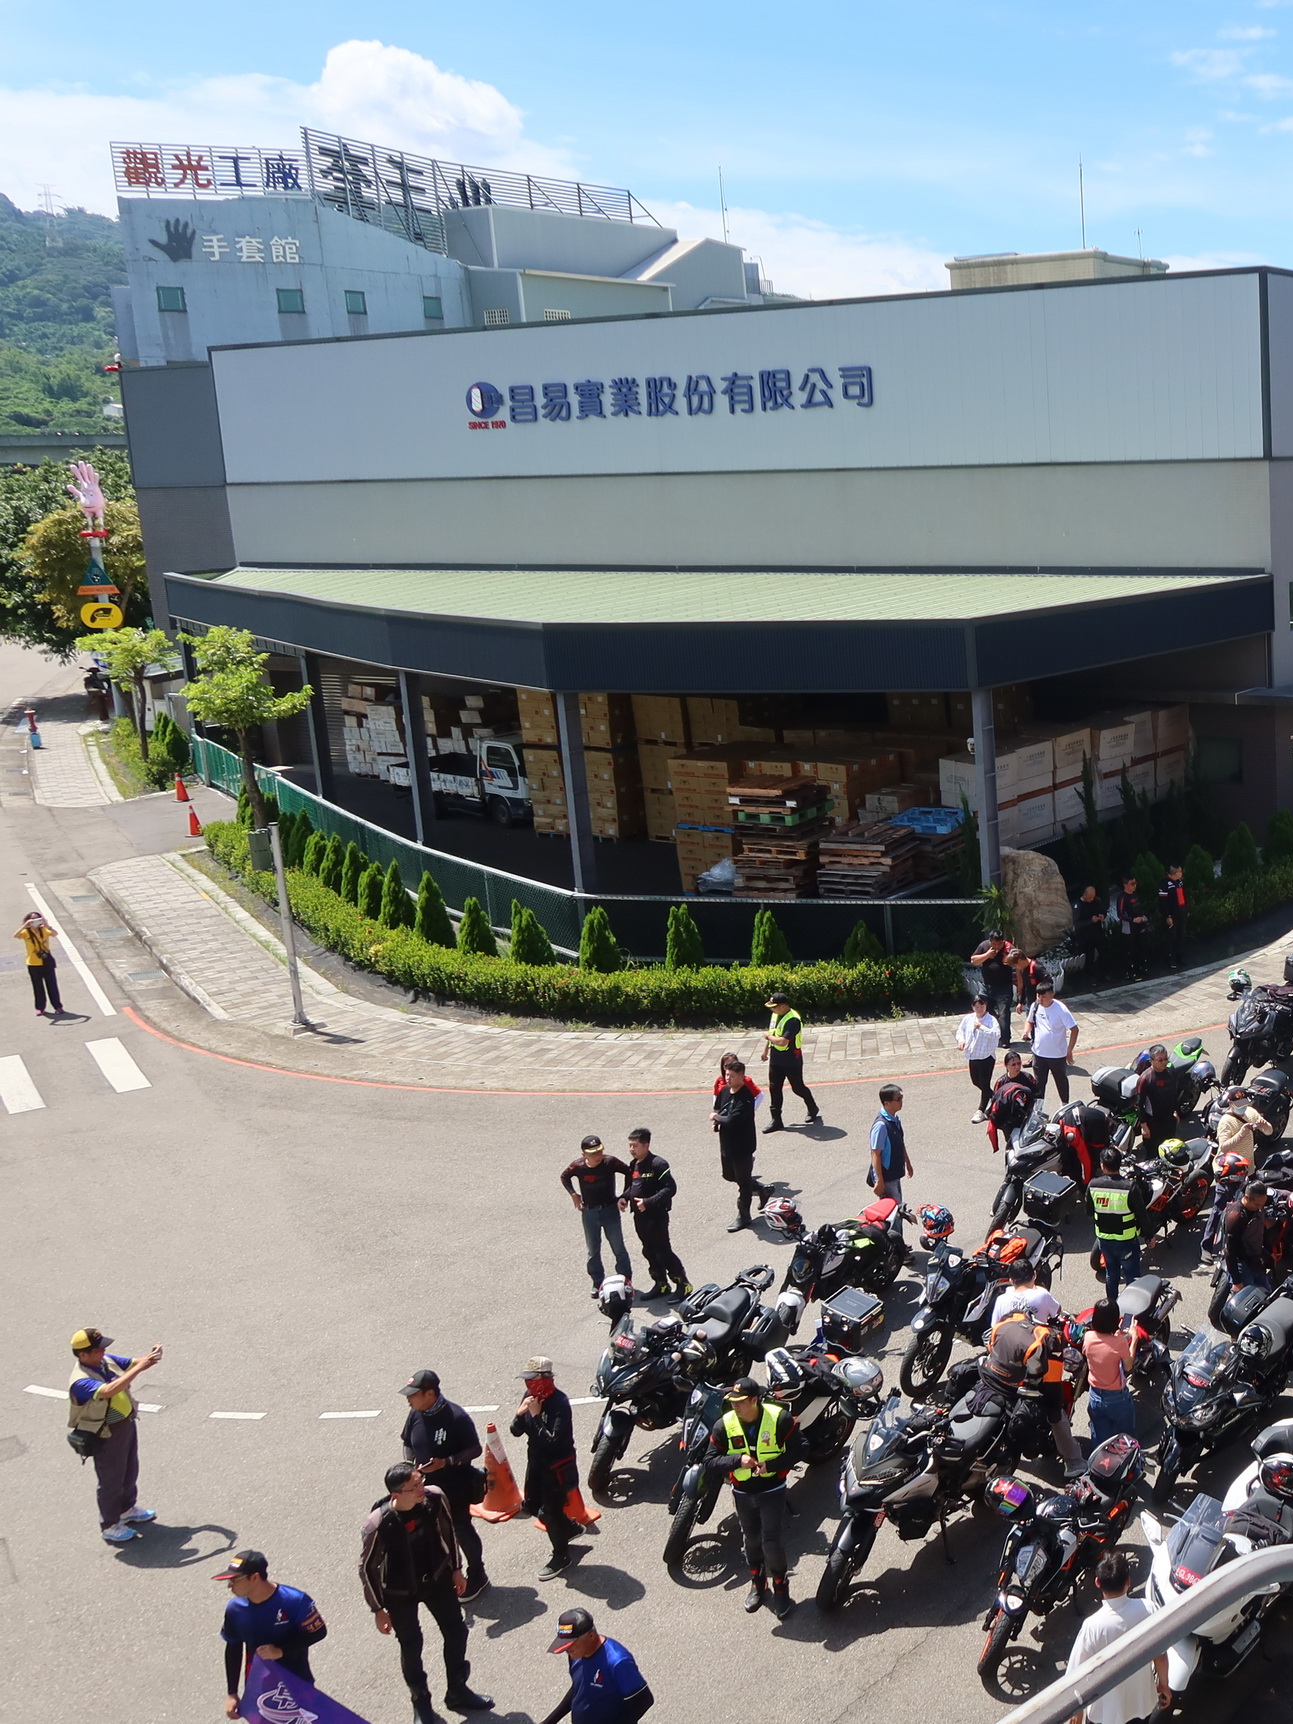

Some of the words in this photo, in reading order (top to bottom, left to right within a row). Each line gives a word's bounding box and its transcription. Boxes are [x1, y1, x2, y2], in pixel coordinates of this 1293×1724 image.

[120, 149, 303, 191] 觀光工廠
[201, 233, 300, 263] 手套館
[508, 365, 873, 423] 昌易實業股份有限公司
[468, 421, 490, 430] SINCE
